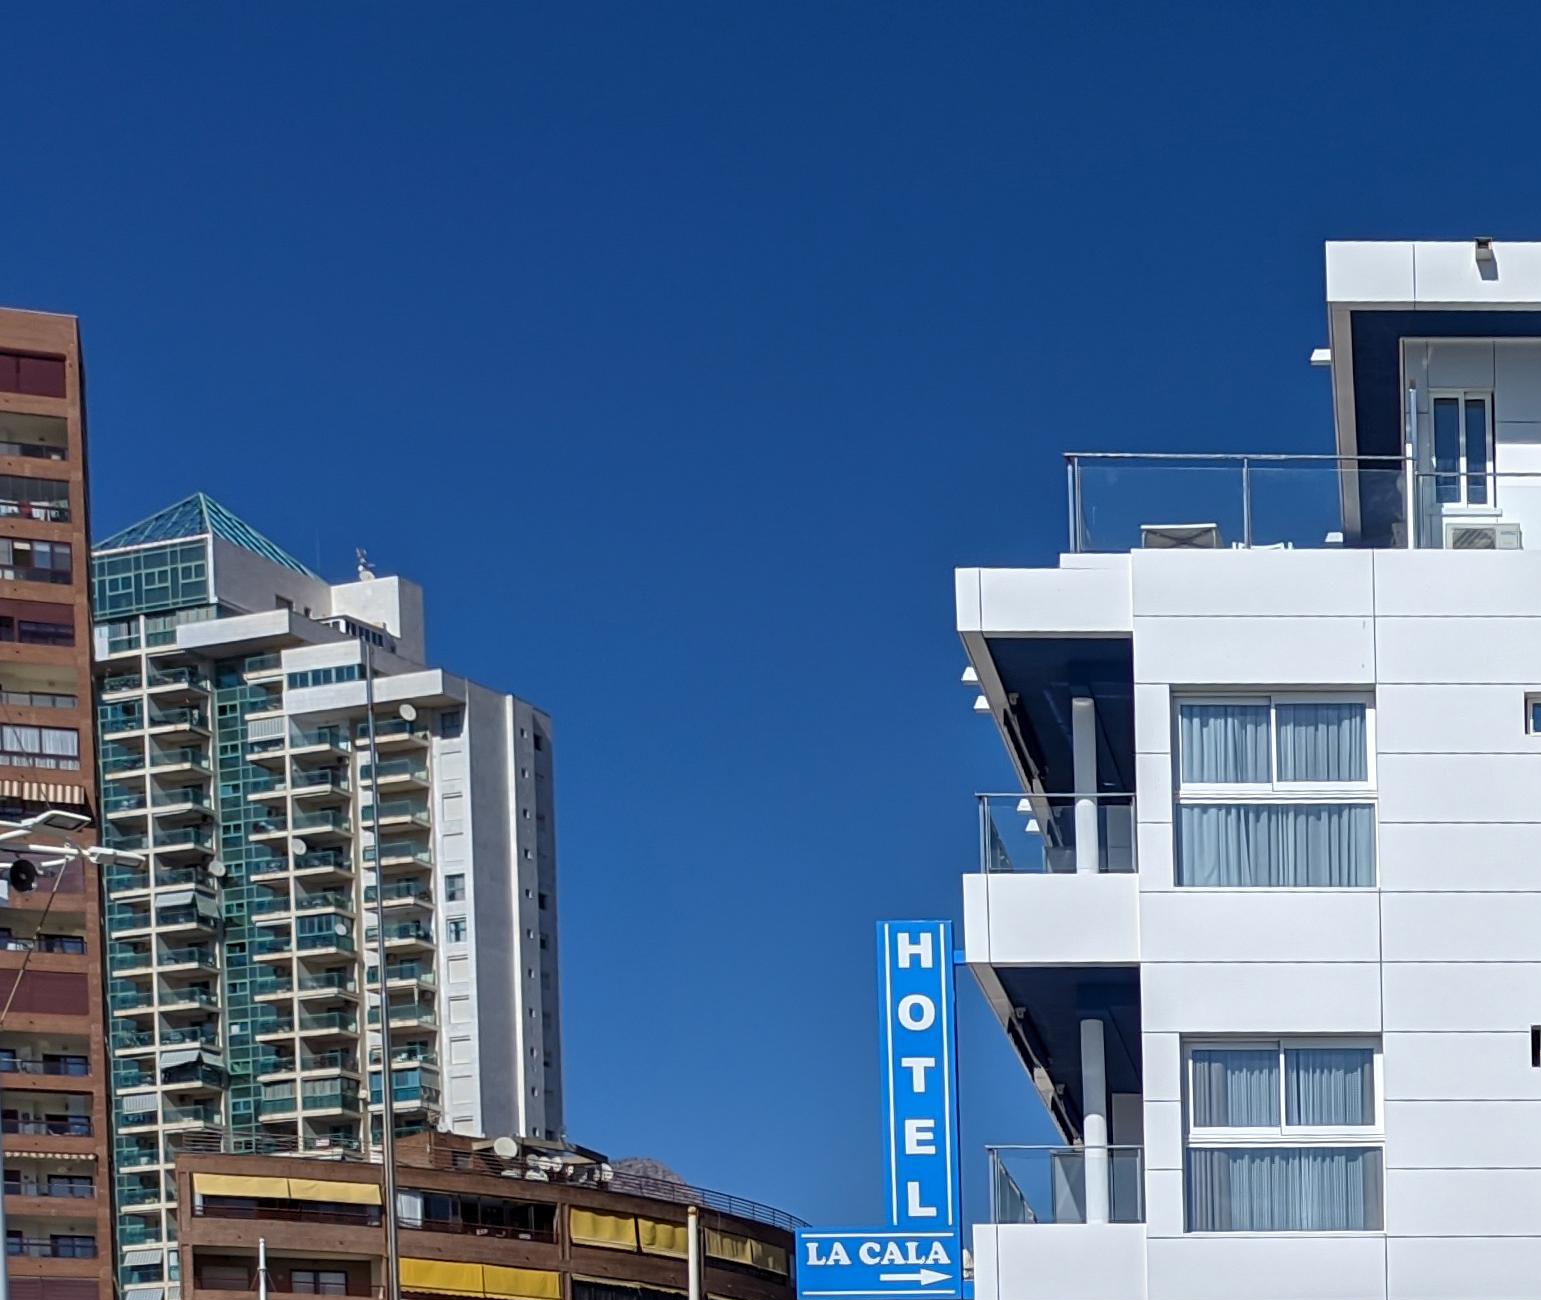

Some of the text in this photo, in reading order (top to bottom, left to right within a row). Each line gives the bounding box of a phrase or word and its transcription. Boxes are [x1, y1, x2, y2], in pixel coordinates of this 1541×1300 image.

[897, 932, 937, 1217] HOTEL
[805, 1241, 951, 1265] LA CALA
